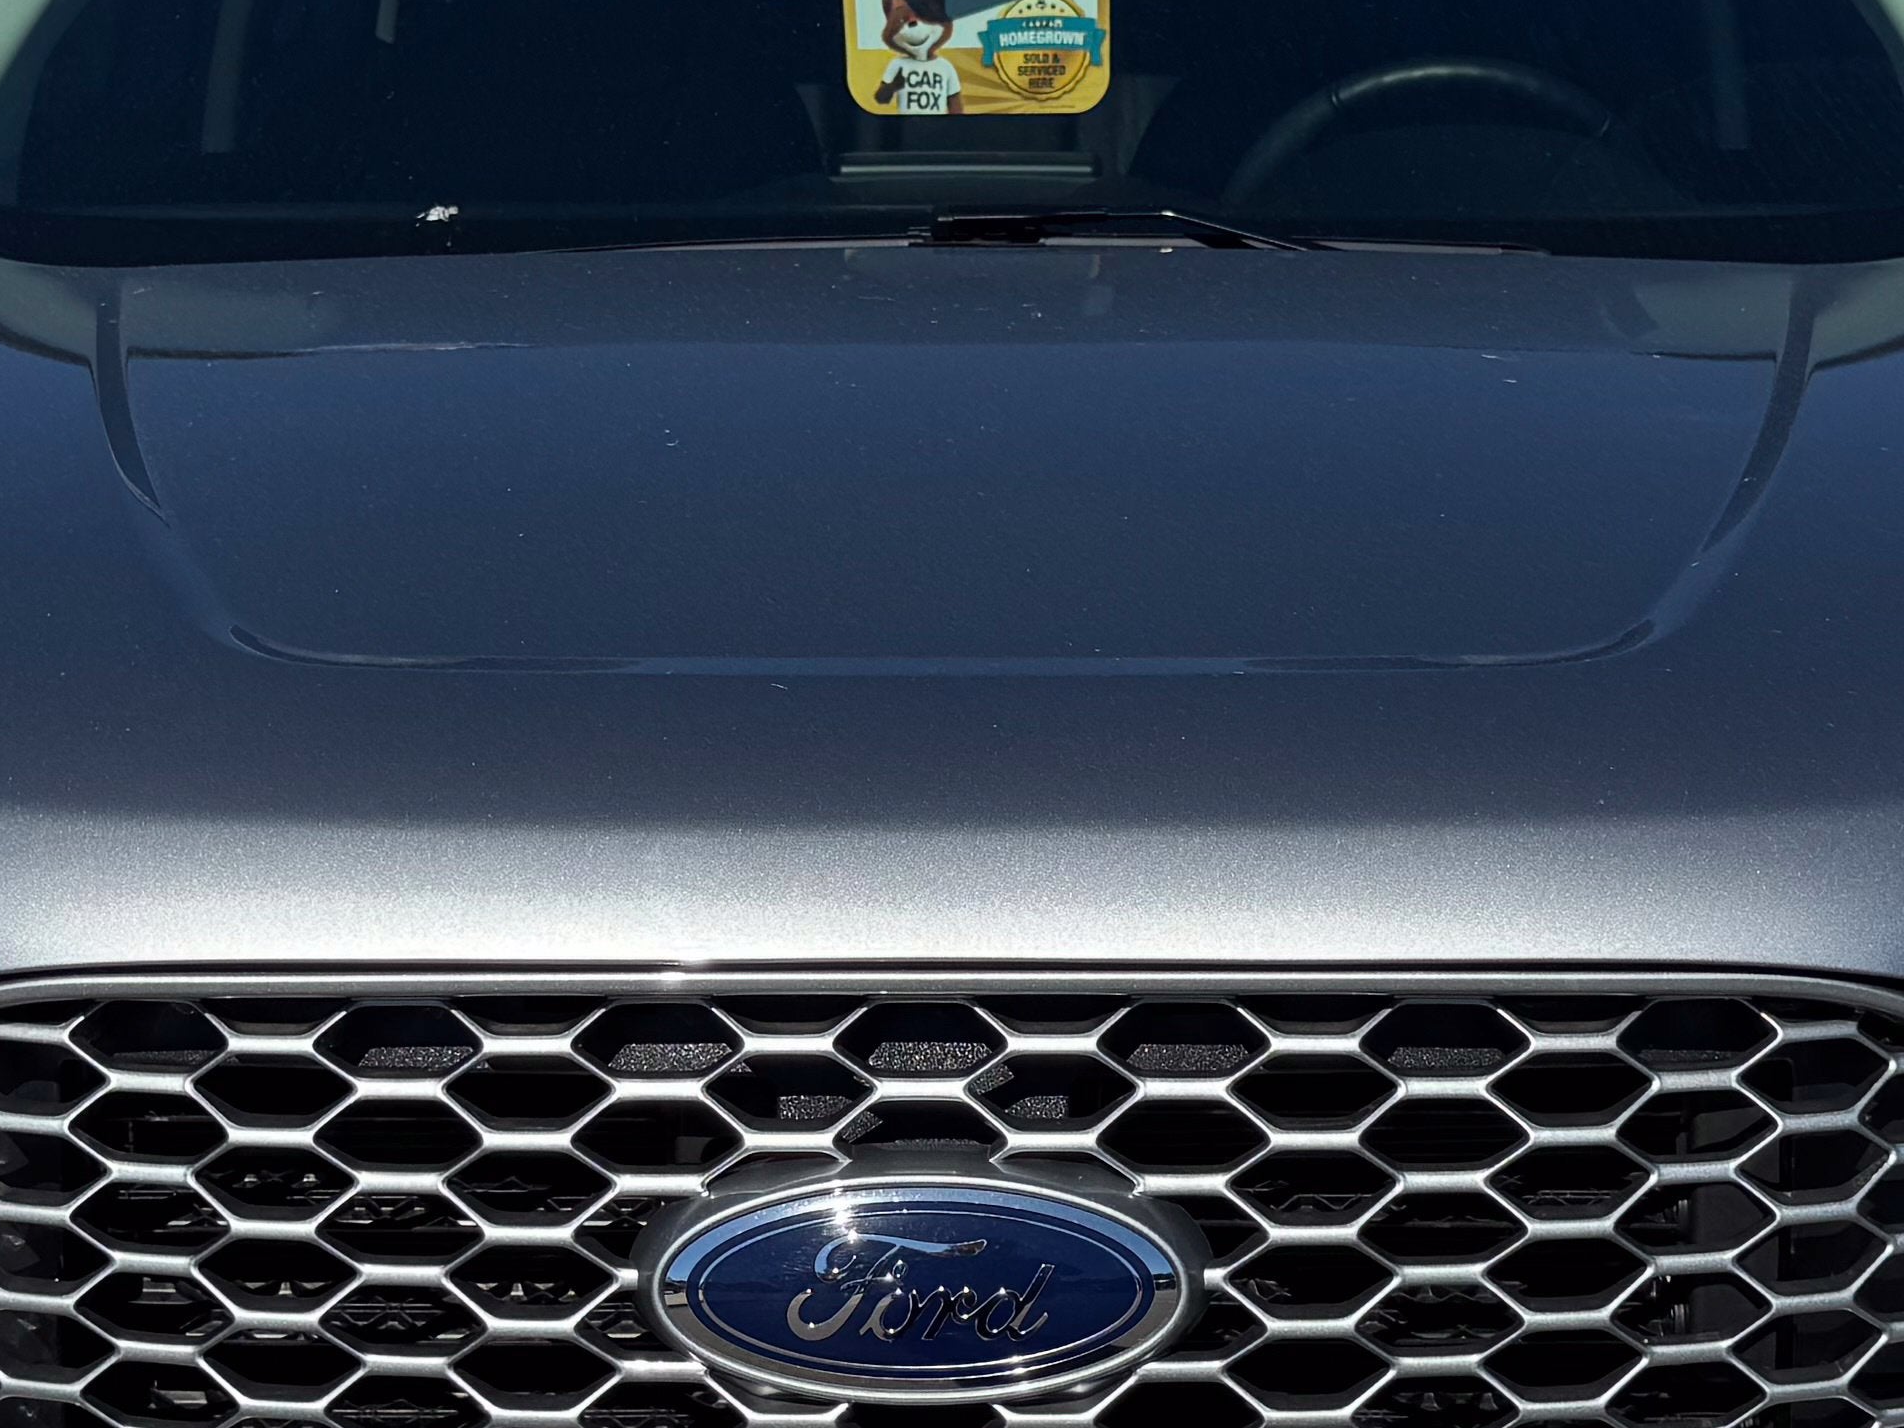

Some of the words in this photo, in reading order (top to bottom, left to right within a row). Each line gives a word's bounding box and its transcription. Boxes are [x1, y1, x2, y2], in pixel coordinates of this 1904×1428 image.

[999, 30, 1087, 47] HOMEGROWN
[907, 70, 943, 89] CAR
[907, 91, 942, 110] FOX
[786, 1232, 1056, 1342] Ford
